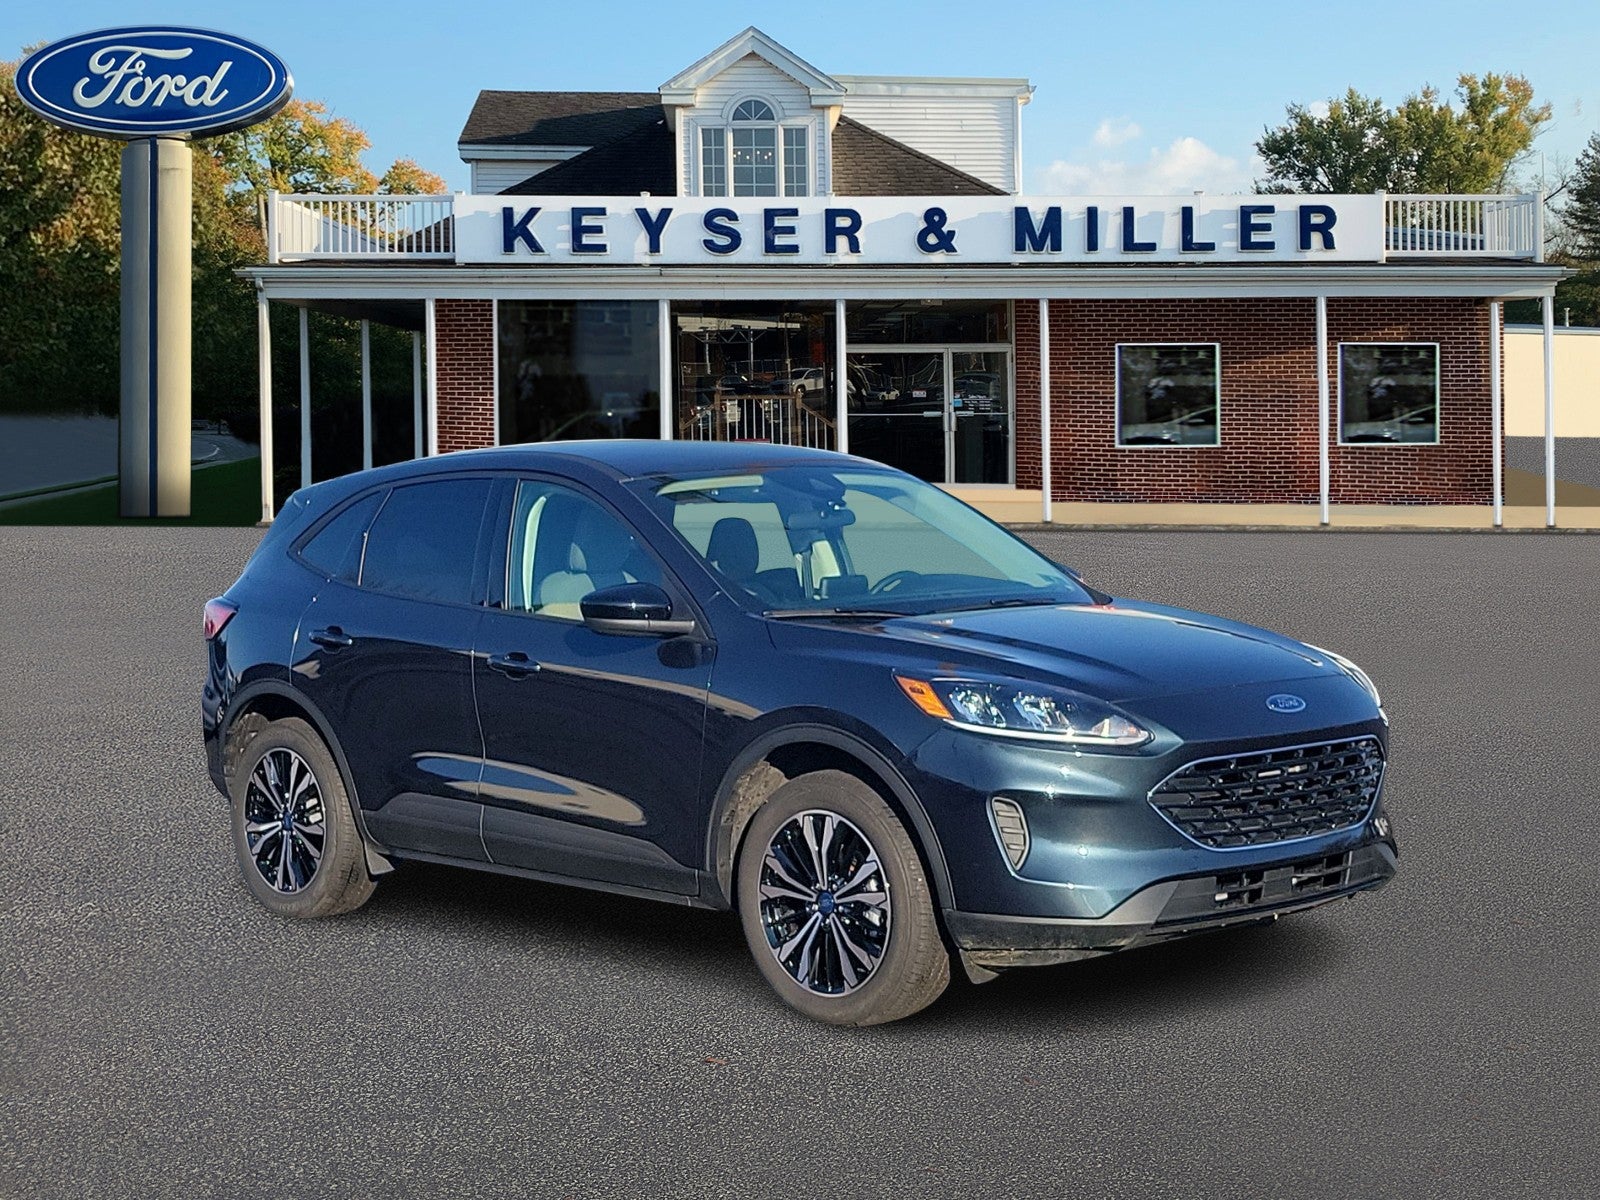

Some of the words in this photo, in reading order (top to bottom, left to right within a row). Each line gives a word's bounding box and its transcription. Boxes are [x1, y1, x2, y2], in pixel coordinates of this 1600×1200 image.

[72, 45, 233, 108] Ford
[501, 206, 864, 254] KEYSER
[915, 206, 958, 255] &
[1013, 204, 1338, 253] MILLER
